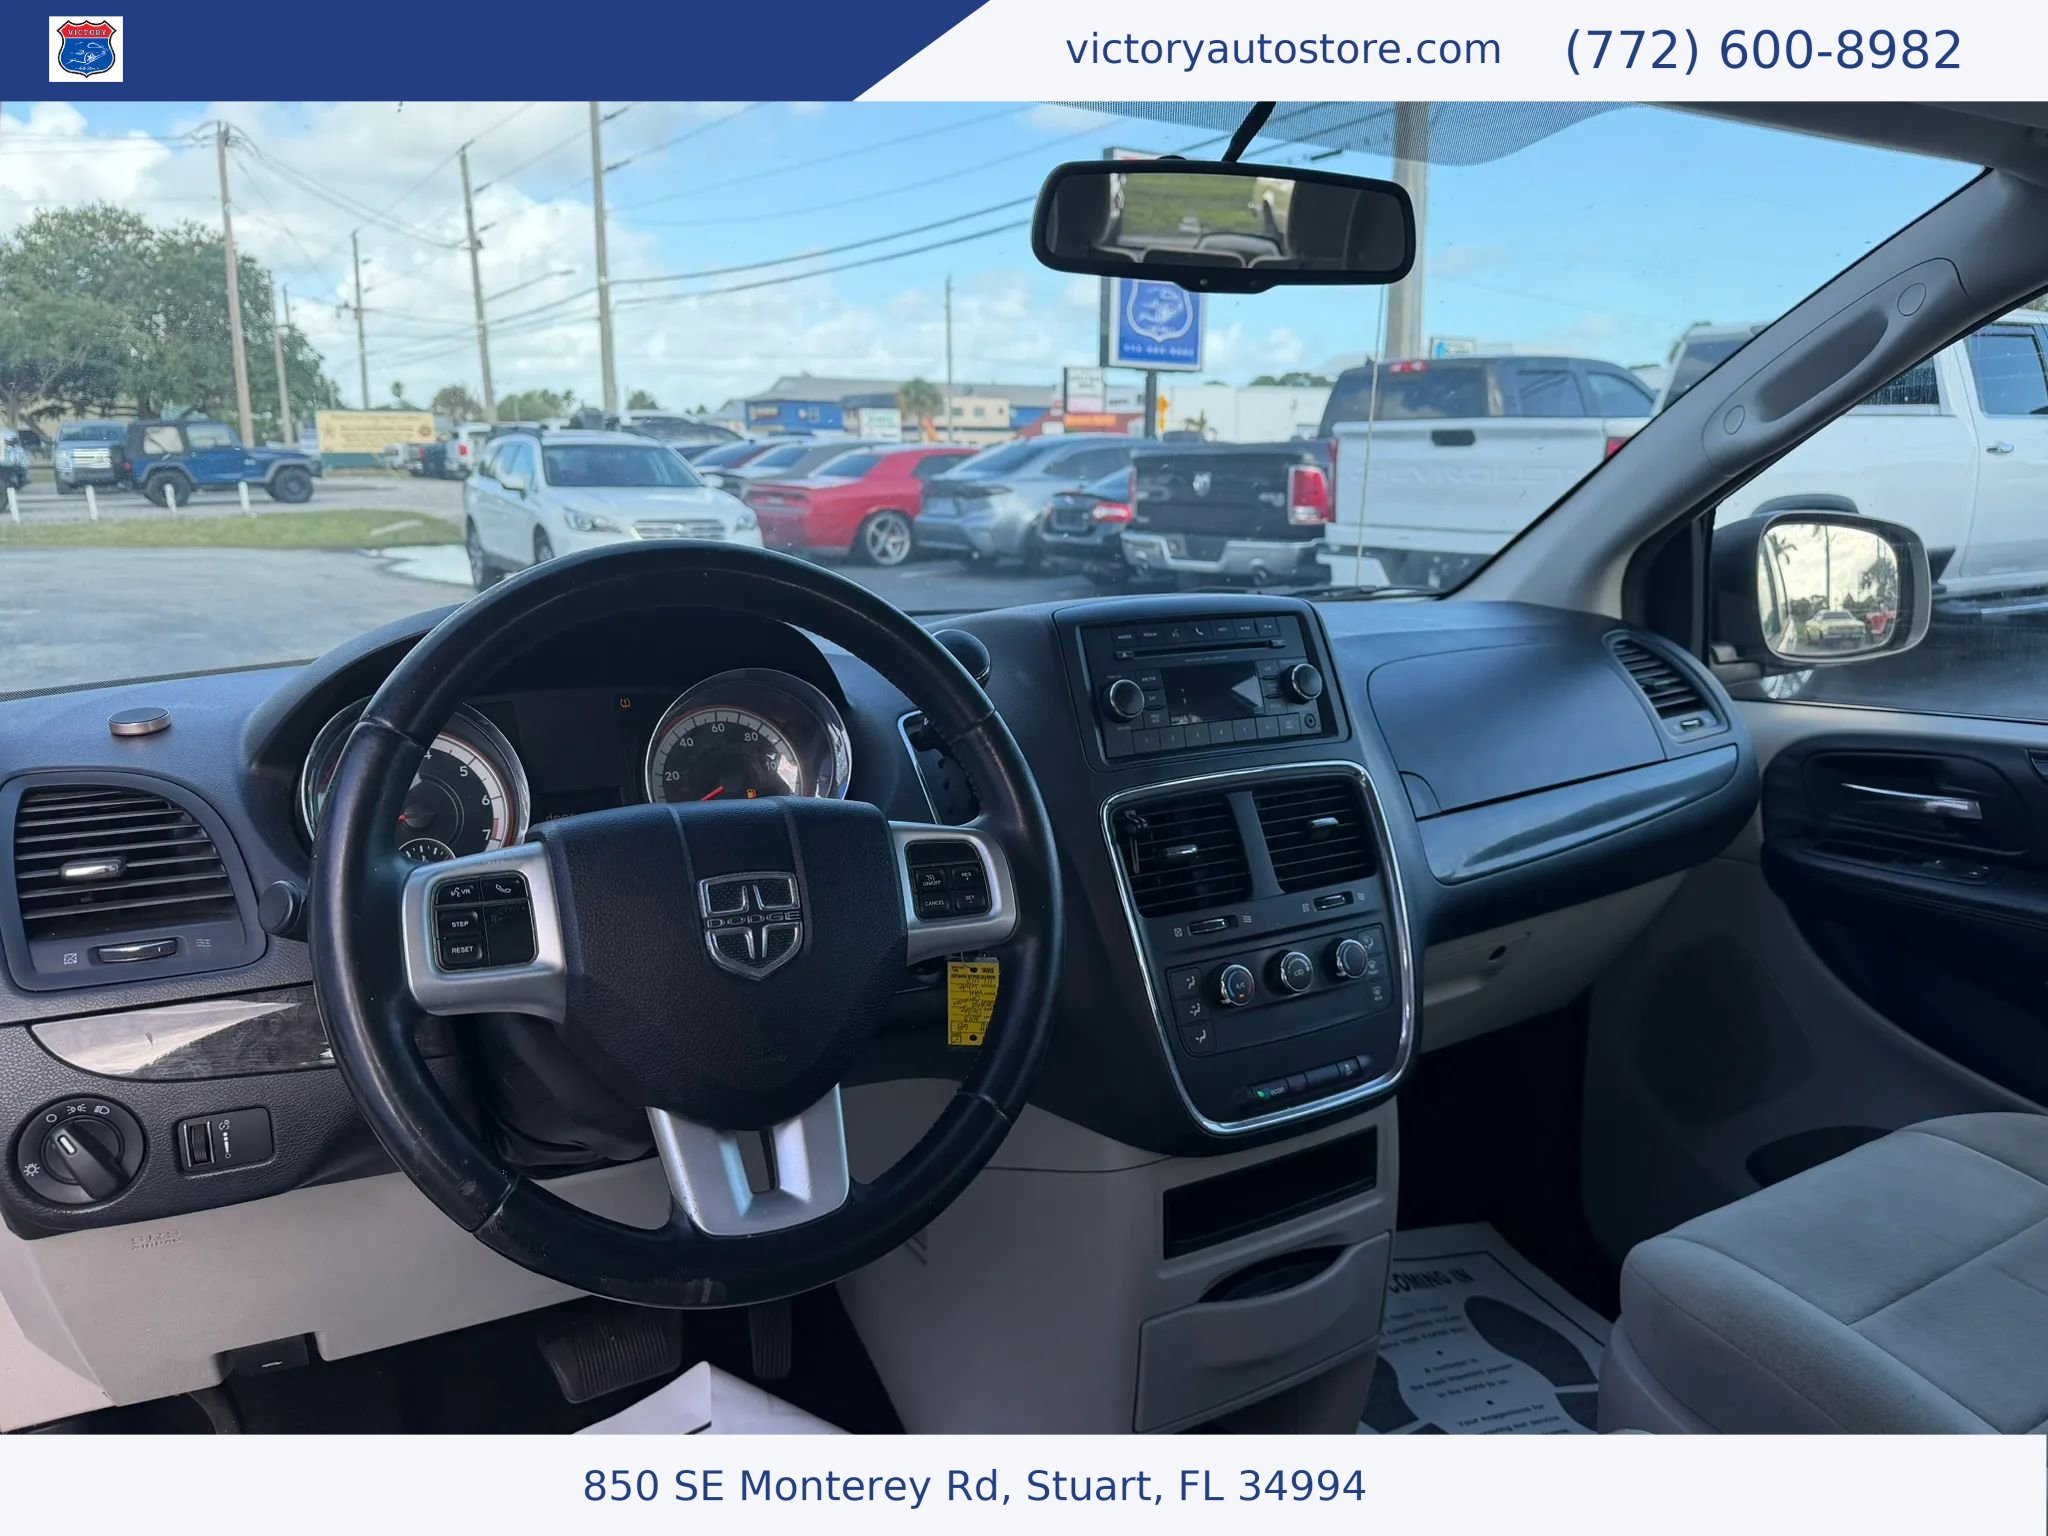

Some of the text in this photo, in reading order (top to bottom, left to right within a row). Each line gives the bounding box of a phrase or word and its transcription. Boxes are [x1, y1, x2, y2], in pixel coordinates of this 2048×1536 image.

[711, 723, 725, 733] 60
[743, 732, 759, 742] 80
[679, 738, 694, 748] 40
[459, 765, 469, 777] 5
[664, 771, 680, 782] 20
[481, 794, 491, 806] 6
[482, 828, 492, 841] 7
[451, 920, 470, 928] STEP
[706, 911, 801, 929] DODGE
[451, 945, 474, 954] RESET
